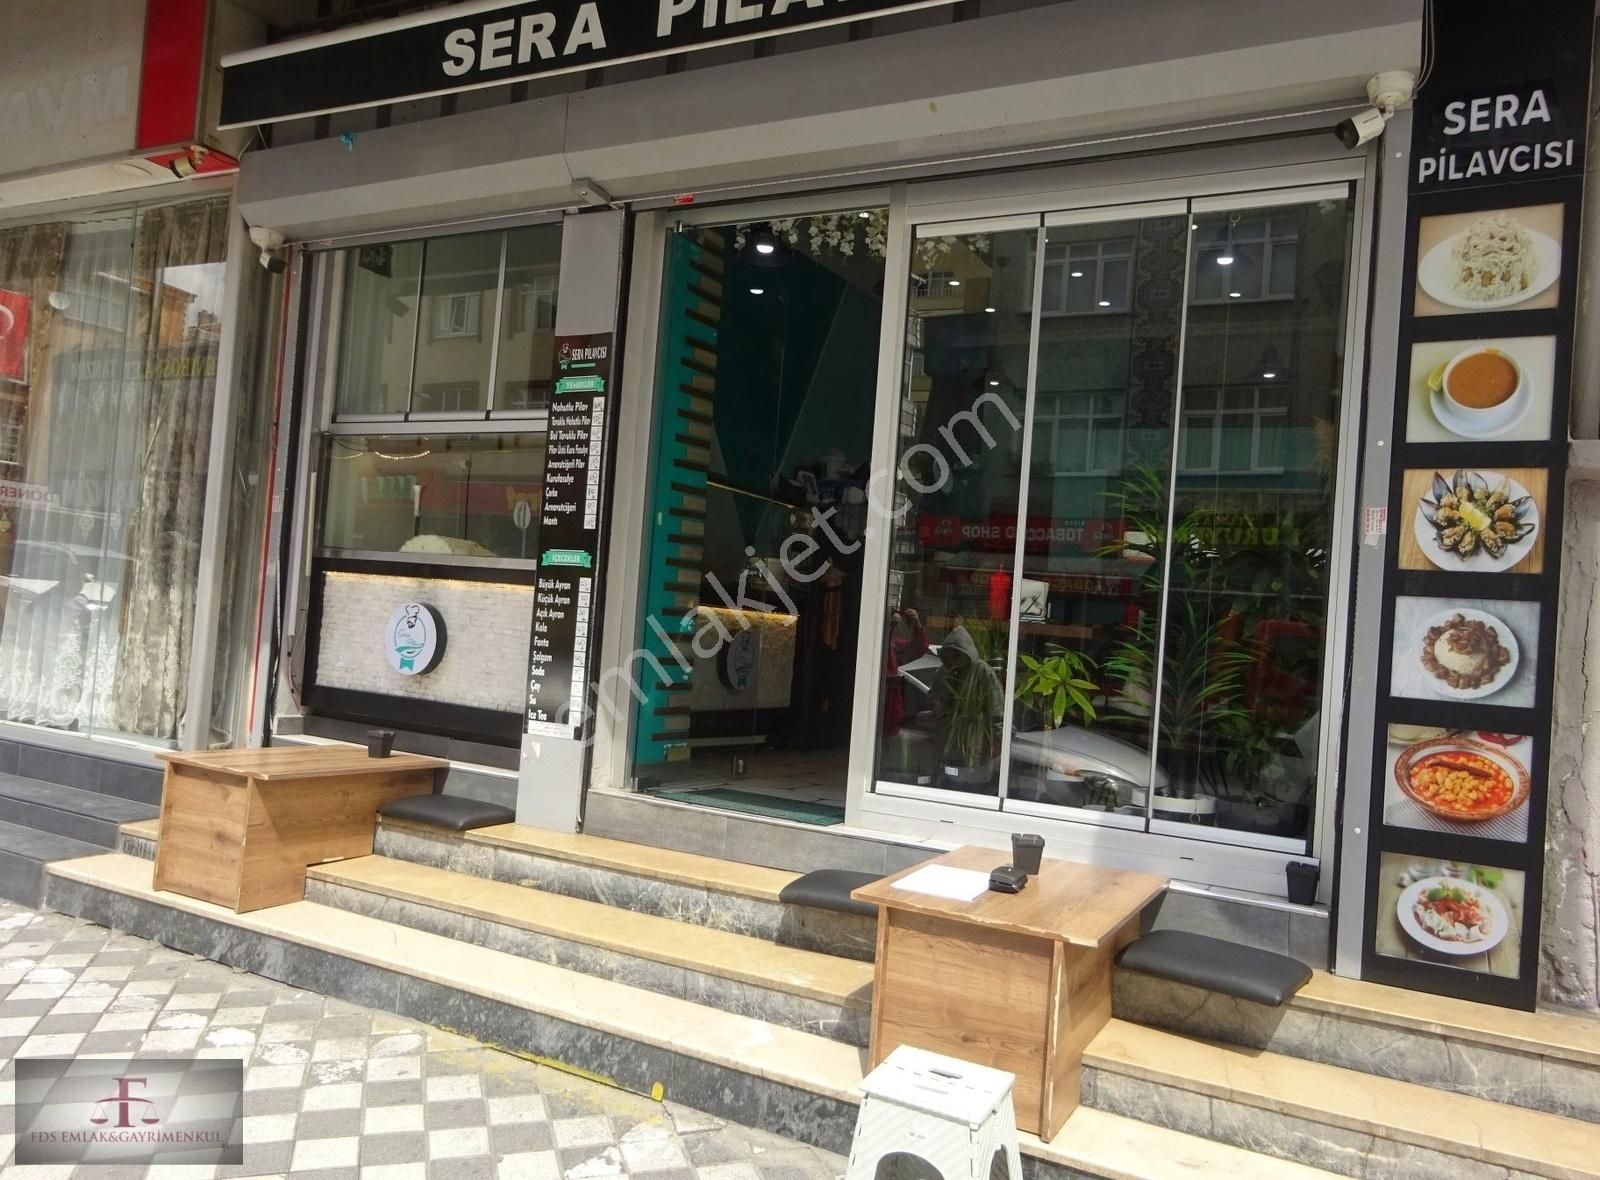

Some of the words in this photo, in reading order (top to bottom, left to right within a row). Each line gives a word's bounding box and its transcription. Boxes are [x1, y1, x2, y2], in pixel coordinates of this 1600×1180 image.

[441, 2, 606, 76] SERA
[1443, 89, 1551, 135] SERA
[1418, 139, 1574, 184] PİLAVCISI
[572, 348, 584, 360] SERA
[566, 380, 594, 390] YEMEKLER
[552, 401, 574, 412] Nohutlu
[575, 401, 588, 411] Pilav
[559, 430, 576, 440] Tavuklu
[577, 430, 588, 440] Pilav
[546, 473, 574, 485] Kurufasulye
[538, 578, 554, 591] Büyük
[555, 579, 571, 592] Ayran
[537, 593, 553, 606] Küçük
[554, 594, 570, 607] Ayran
[549, 608, 564, 620] Ayran
[535, 621, 547, 632] Kola
[534, 636, 549, 647] Fanta
[533, 650, 552, 664] Şalgam
[531, 665, 545, 676] Soda
[530, 680, 541, 693] Çay
[529, 693, 537, 705] Su
[528, 708, 537, 720] Ice
[537, 709, 547, 720] Tea
